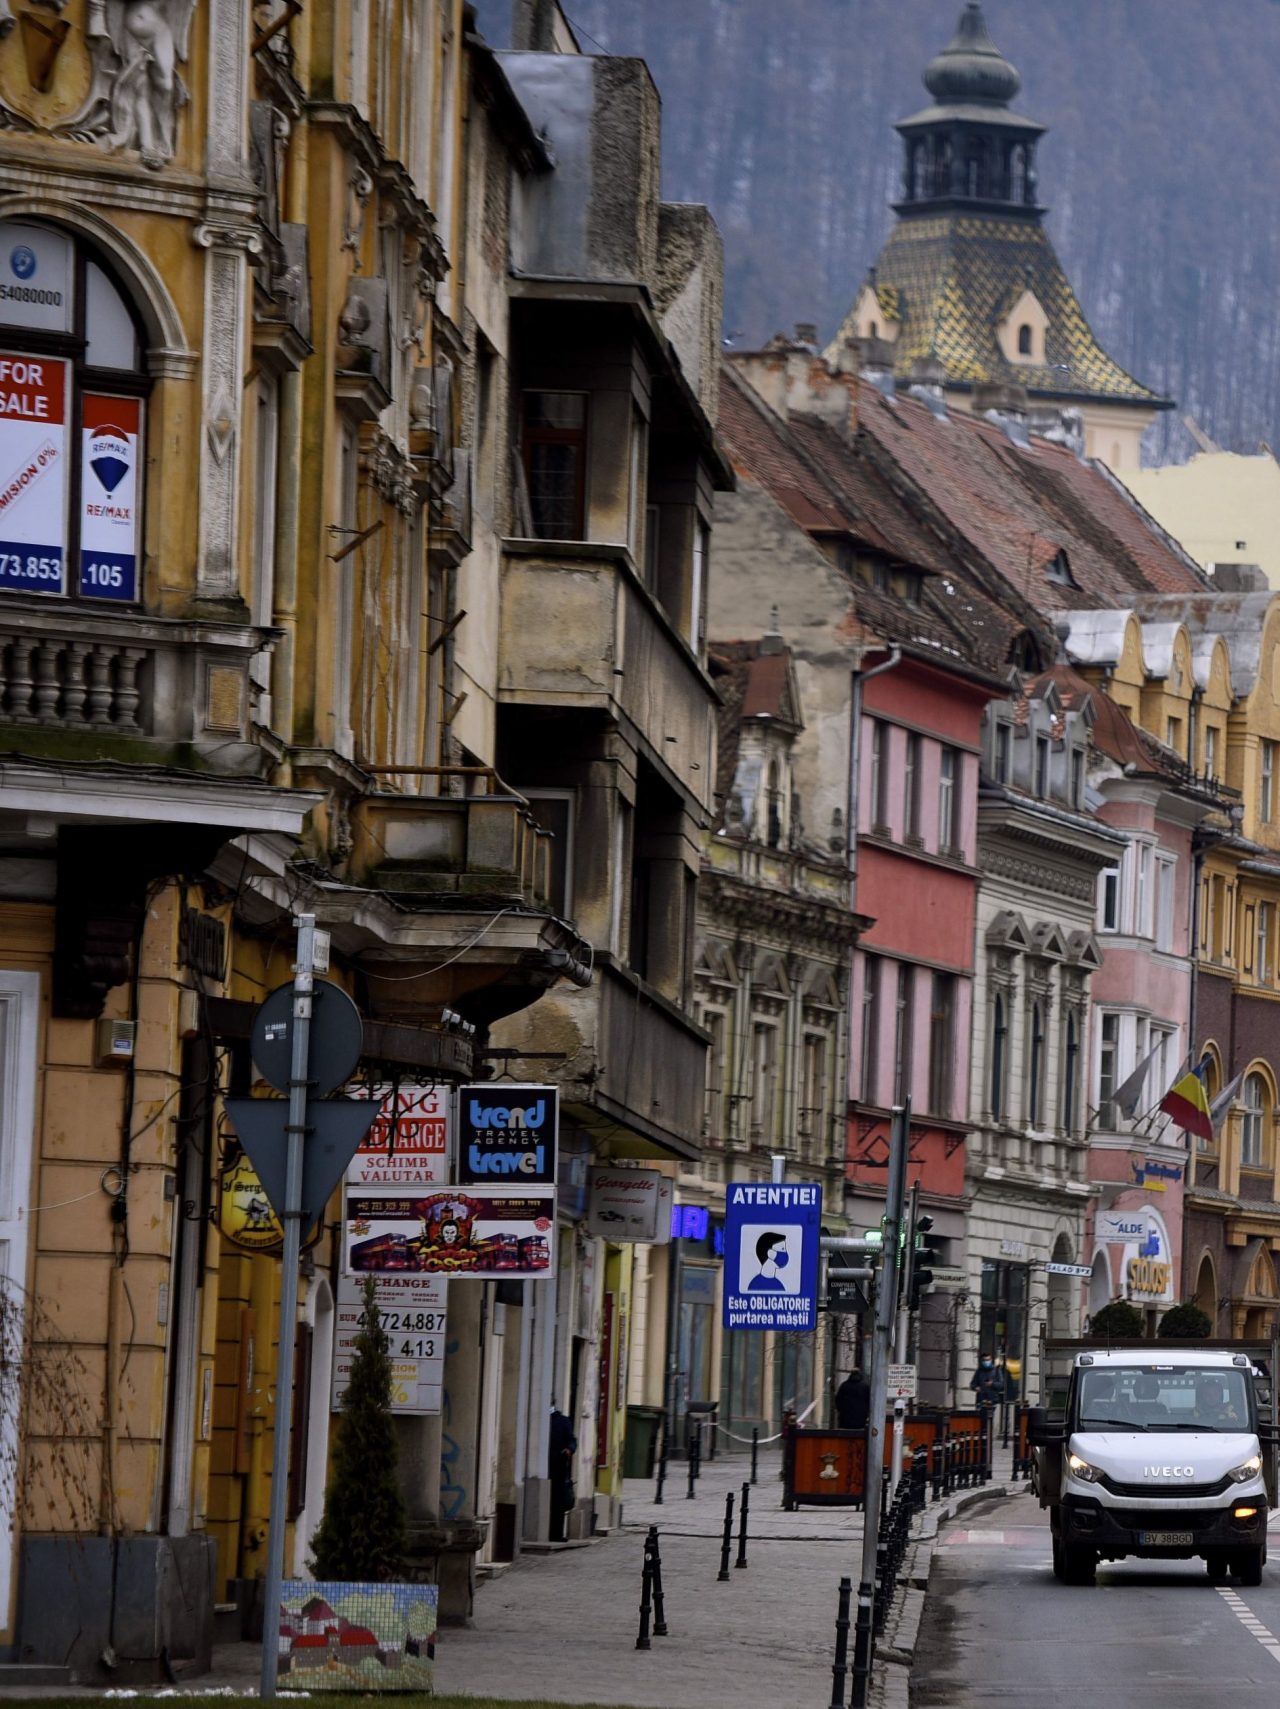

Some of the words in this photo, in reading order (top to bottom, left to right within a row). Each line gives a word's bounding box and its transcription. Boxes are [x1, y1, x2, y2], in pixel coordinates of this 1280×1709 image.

[0, 361, 43, 387] FOR
[86, 503, 131, 520] RE/MAX
[469, 1100, 545, 1129] trend
[475, 1130, 540, 1138] TRAVEL
[366, 1157, 428, 1169] SCHIMB
[469, 1145, 545, 1174] travel
[360, 1170, 434, 1182] VALUTAR
[1117, 1223, 1143, 1234] ALDE
[728, 1296, 748, 1310] Este
[750, 1296, 811, 1312] OBLIGATORIE
[401, 1312, 446, 1331] 4,887
[729, 1311, 774, 1327] purtarea
[400, 1340, 435, 1357] 4,13
[1144, 1466, 1195, 1478] IVECO
[1144, 1533, 1158, 1544] BV
